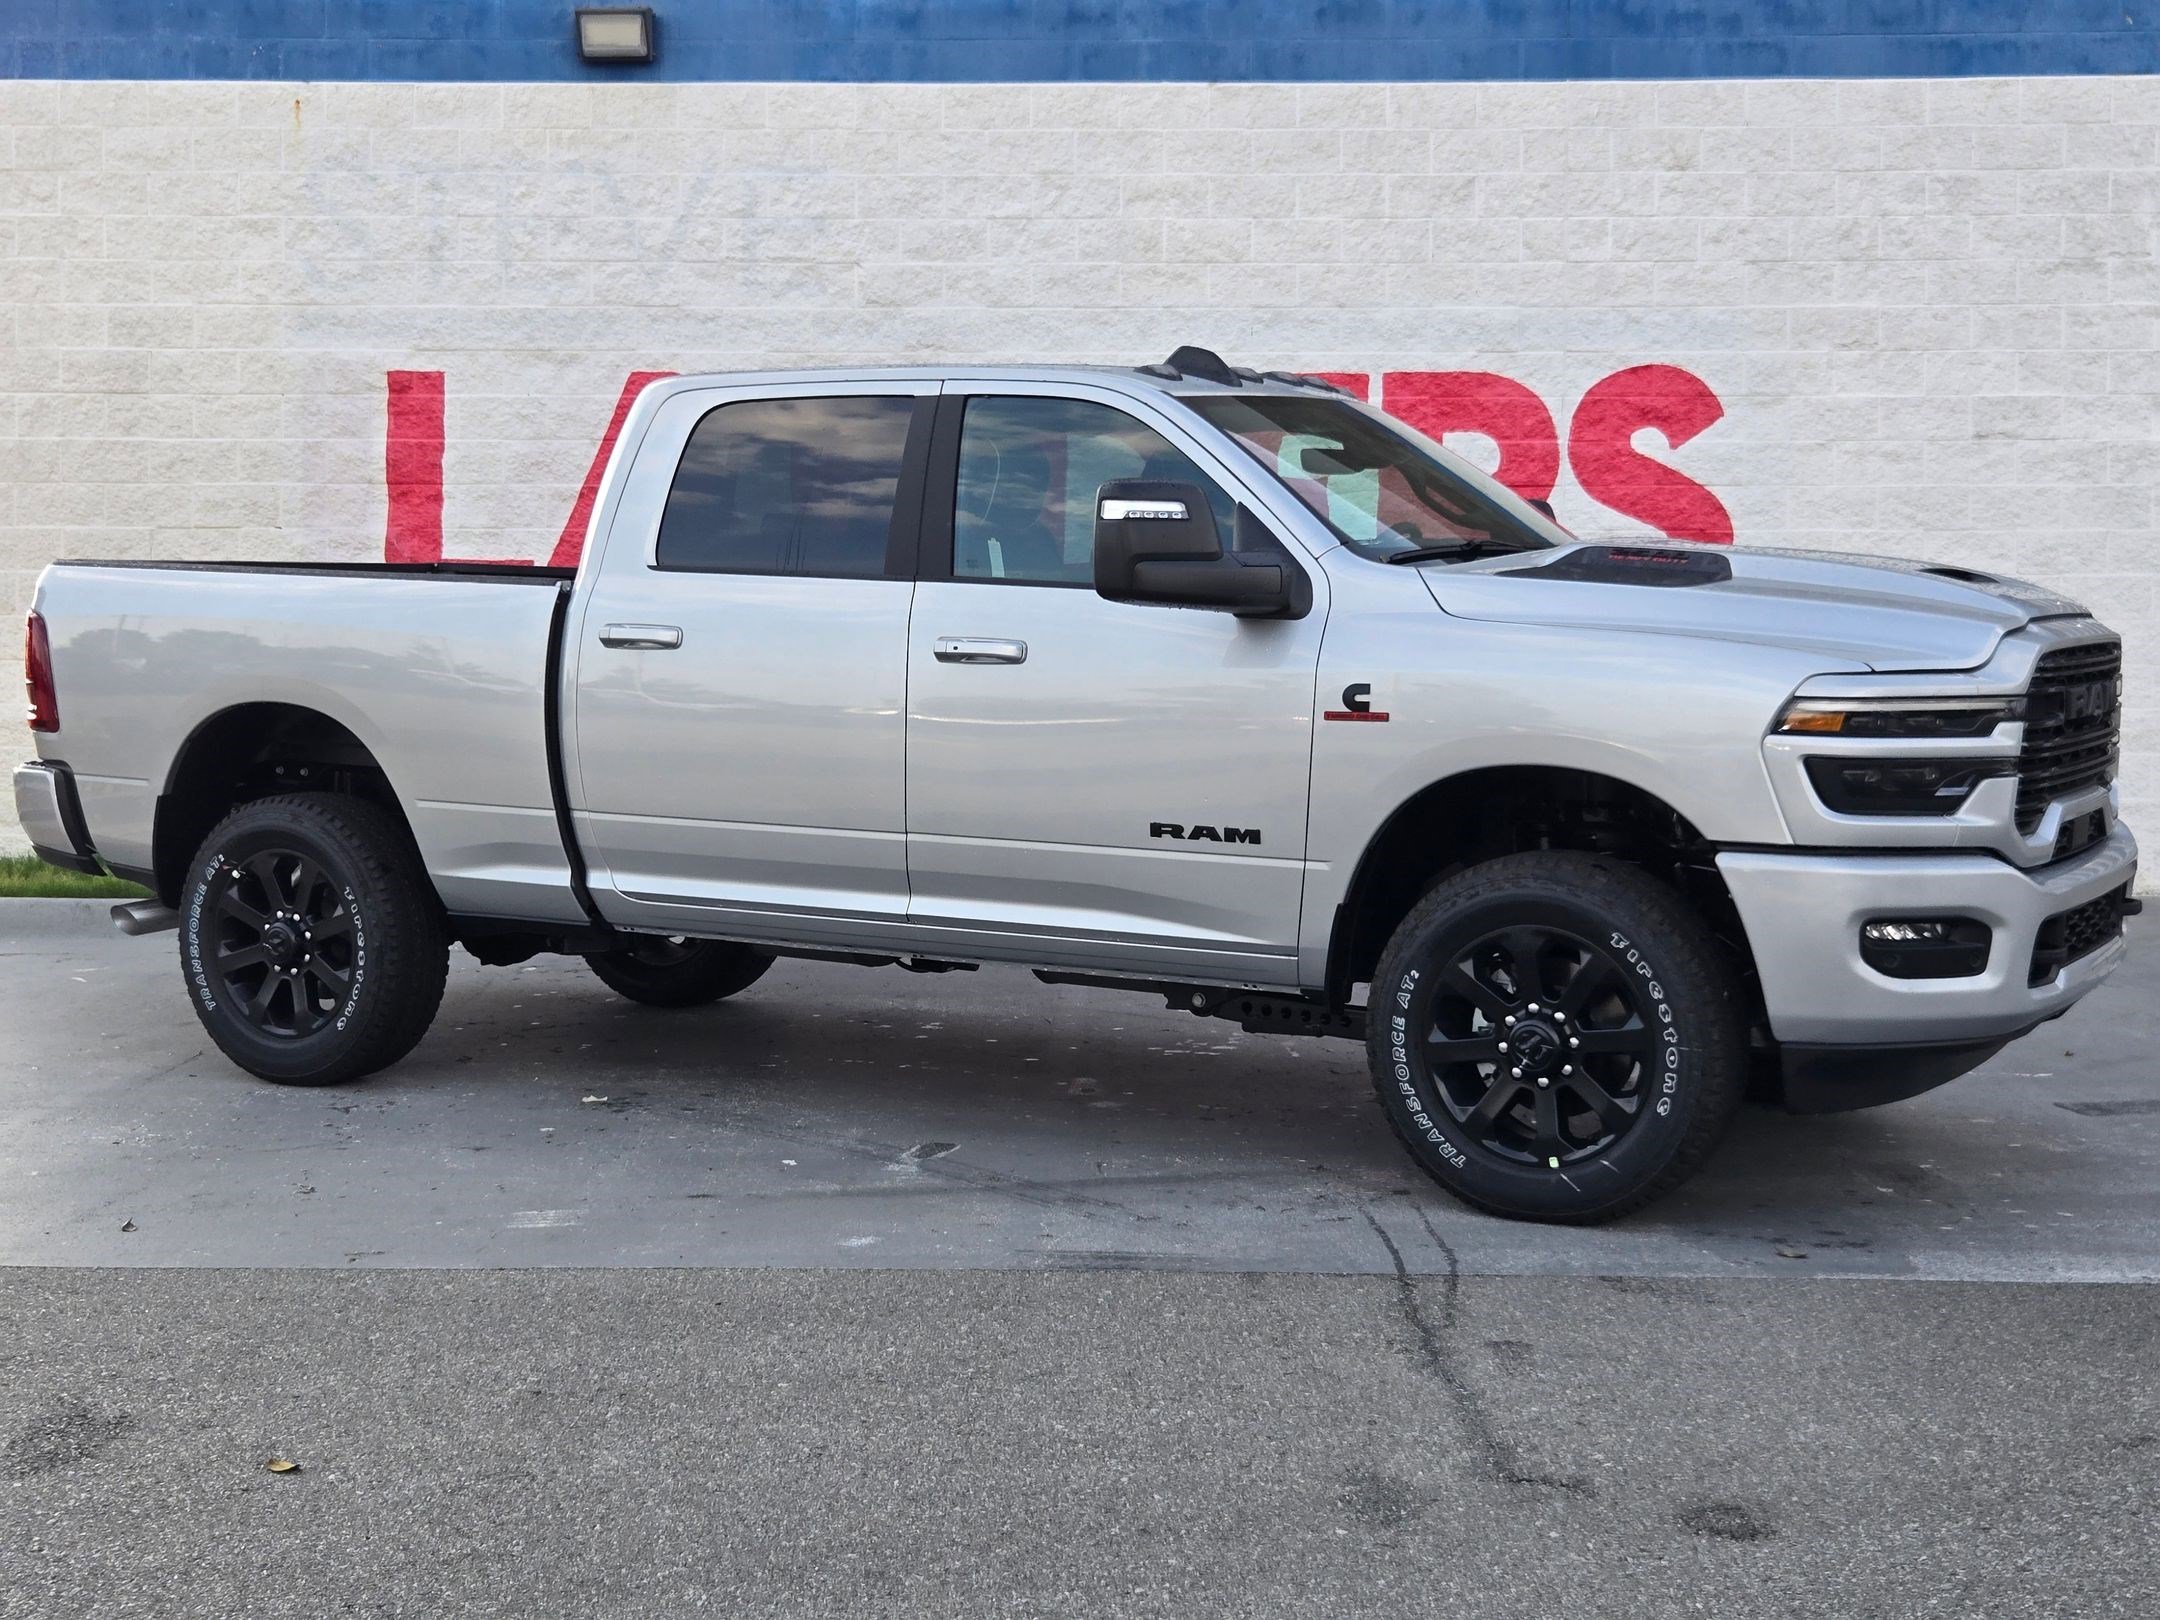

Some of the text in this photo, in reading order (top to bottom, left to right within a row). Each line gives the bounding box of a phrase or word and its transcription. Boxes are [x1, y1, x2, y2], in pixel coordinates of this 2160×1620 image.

[1149, 822, 1261, 845] RAM
[188, 881, 217, 1012] TRANSFORCE
[1391, 1015, 1467, 1169] TRANSFORCE
[1609, 931, 1679, 1117] Firestone
